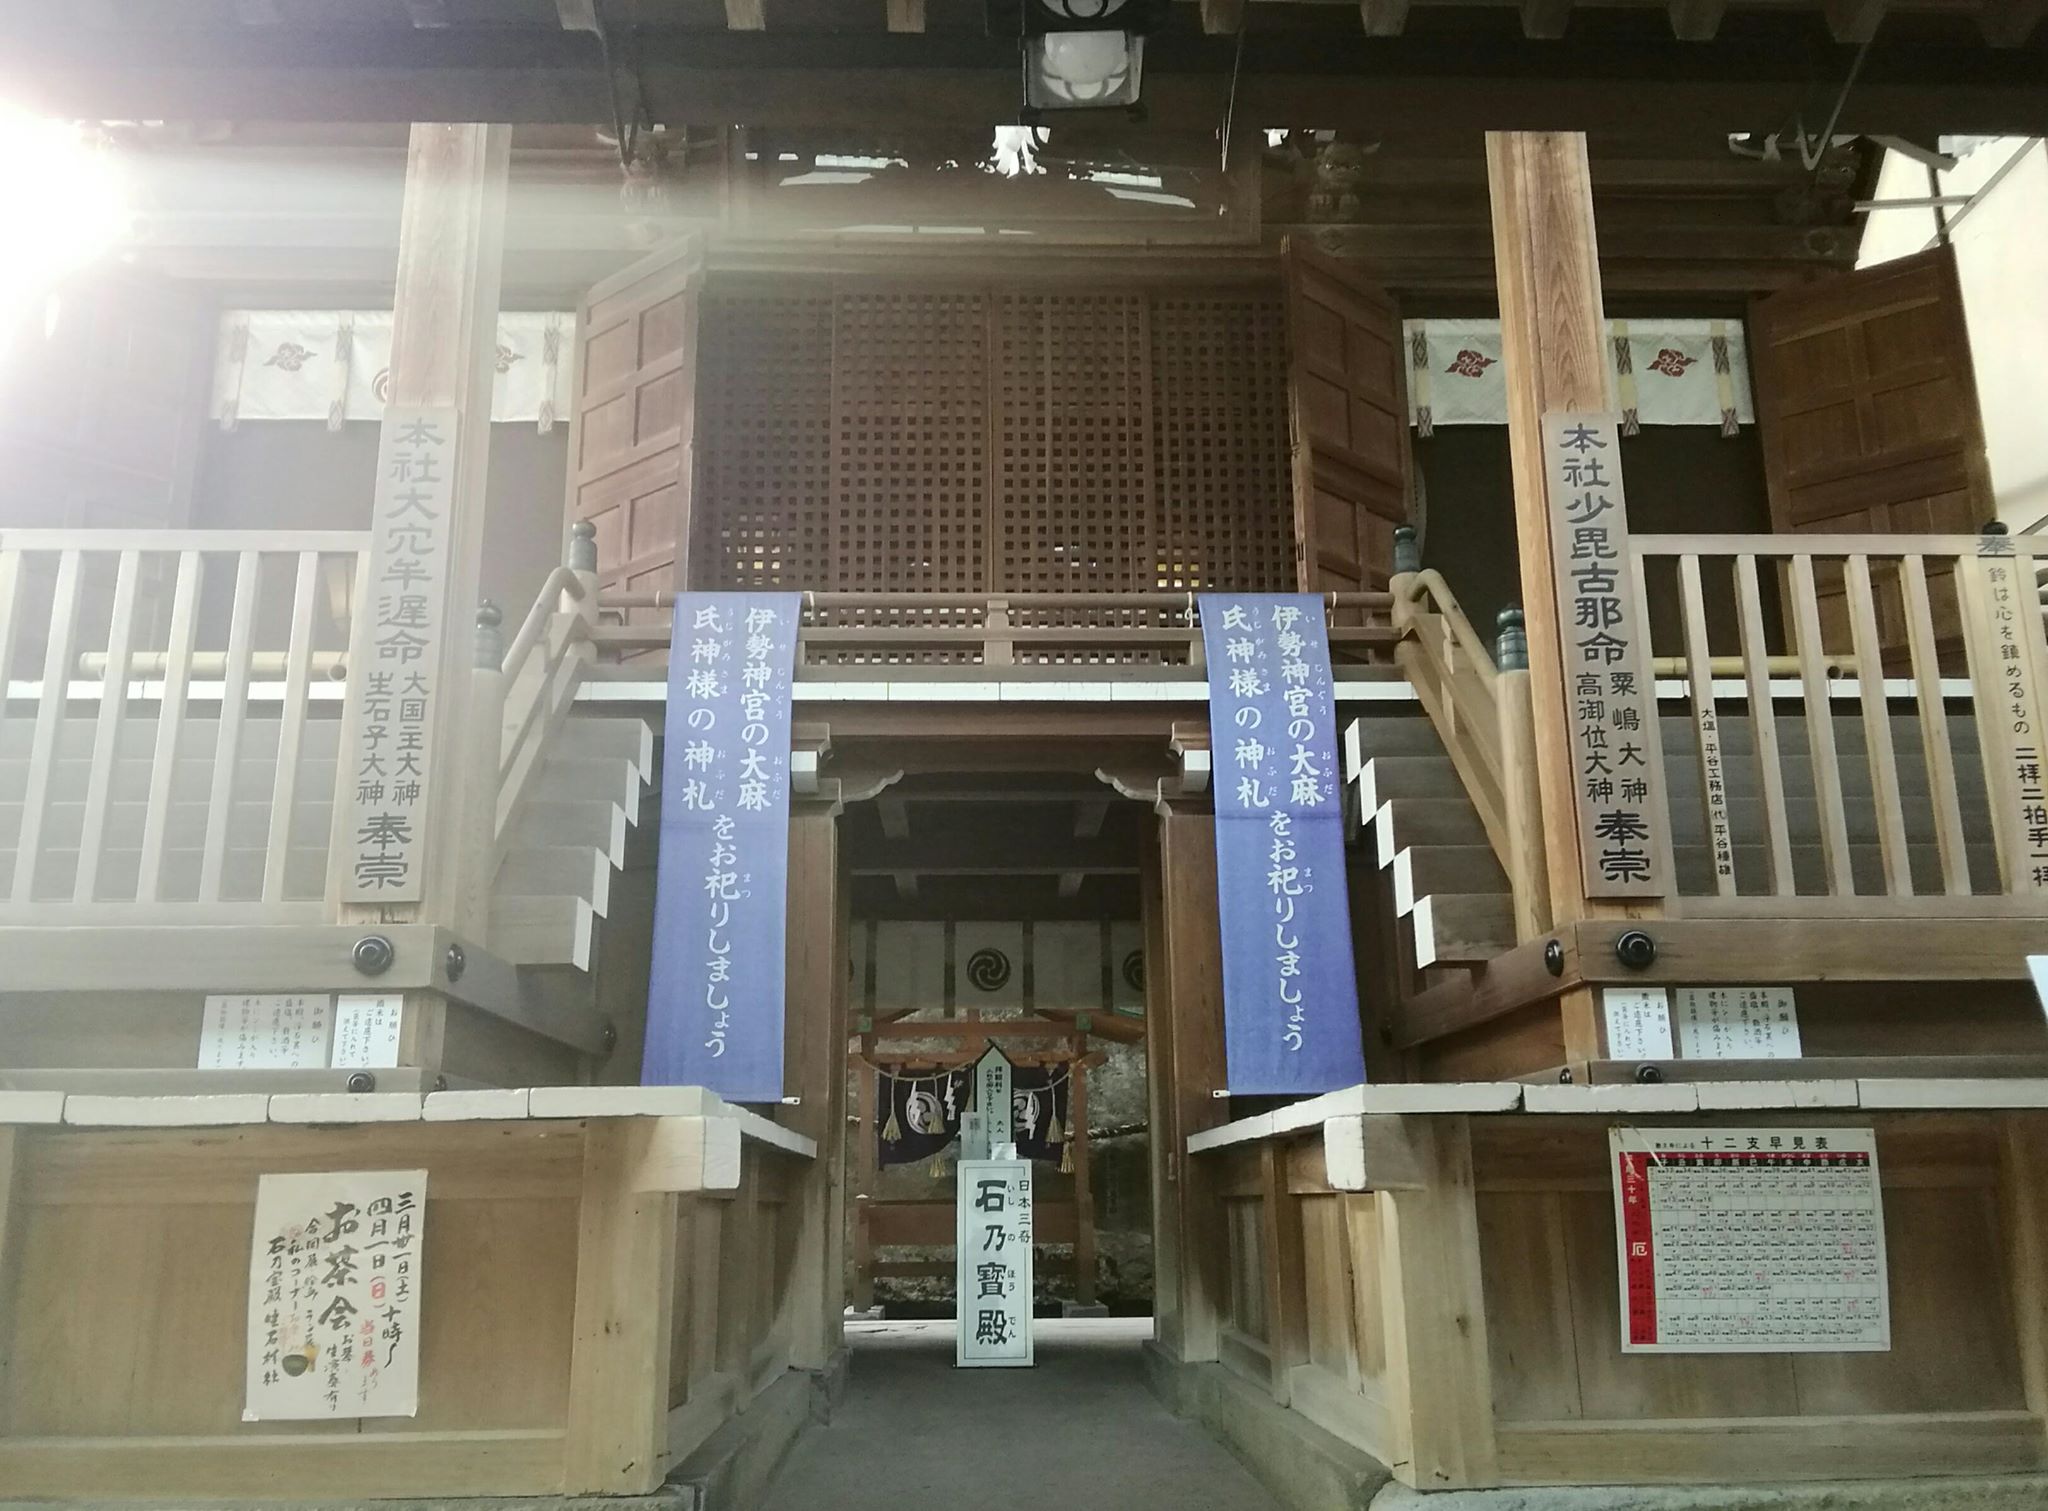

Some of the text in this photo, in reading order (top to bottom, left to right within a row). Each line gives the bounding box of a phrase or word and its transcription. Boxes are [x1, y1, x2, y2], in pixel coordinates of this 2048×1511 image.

[355, 671, 394, 806] 生石子大神
[391, 671, 431, 806] 大国主大神
[682, 605, 724, 811] 氏神様の神札
[737, 605, 776, 812] 伊勢神宮の大麻
[1221, 604, 1269, 808] 氏神様の神札
[1272, 604, 1326, 808] 伊勢神宮の大麻
[1576, 672, 1614, 804] 高御位大神
[704, 815, 740, 1058] をお祀りしましょう
[1267, 810, 1305, 1051] をお祀りしましょう
[1701, 1136, 1829, 1150] 十二支早見表
[318, 1201, 361, 1331] お茶会
[1007, 1233, 1015, 1242] の
